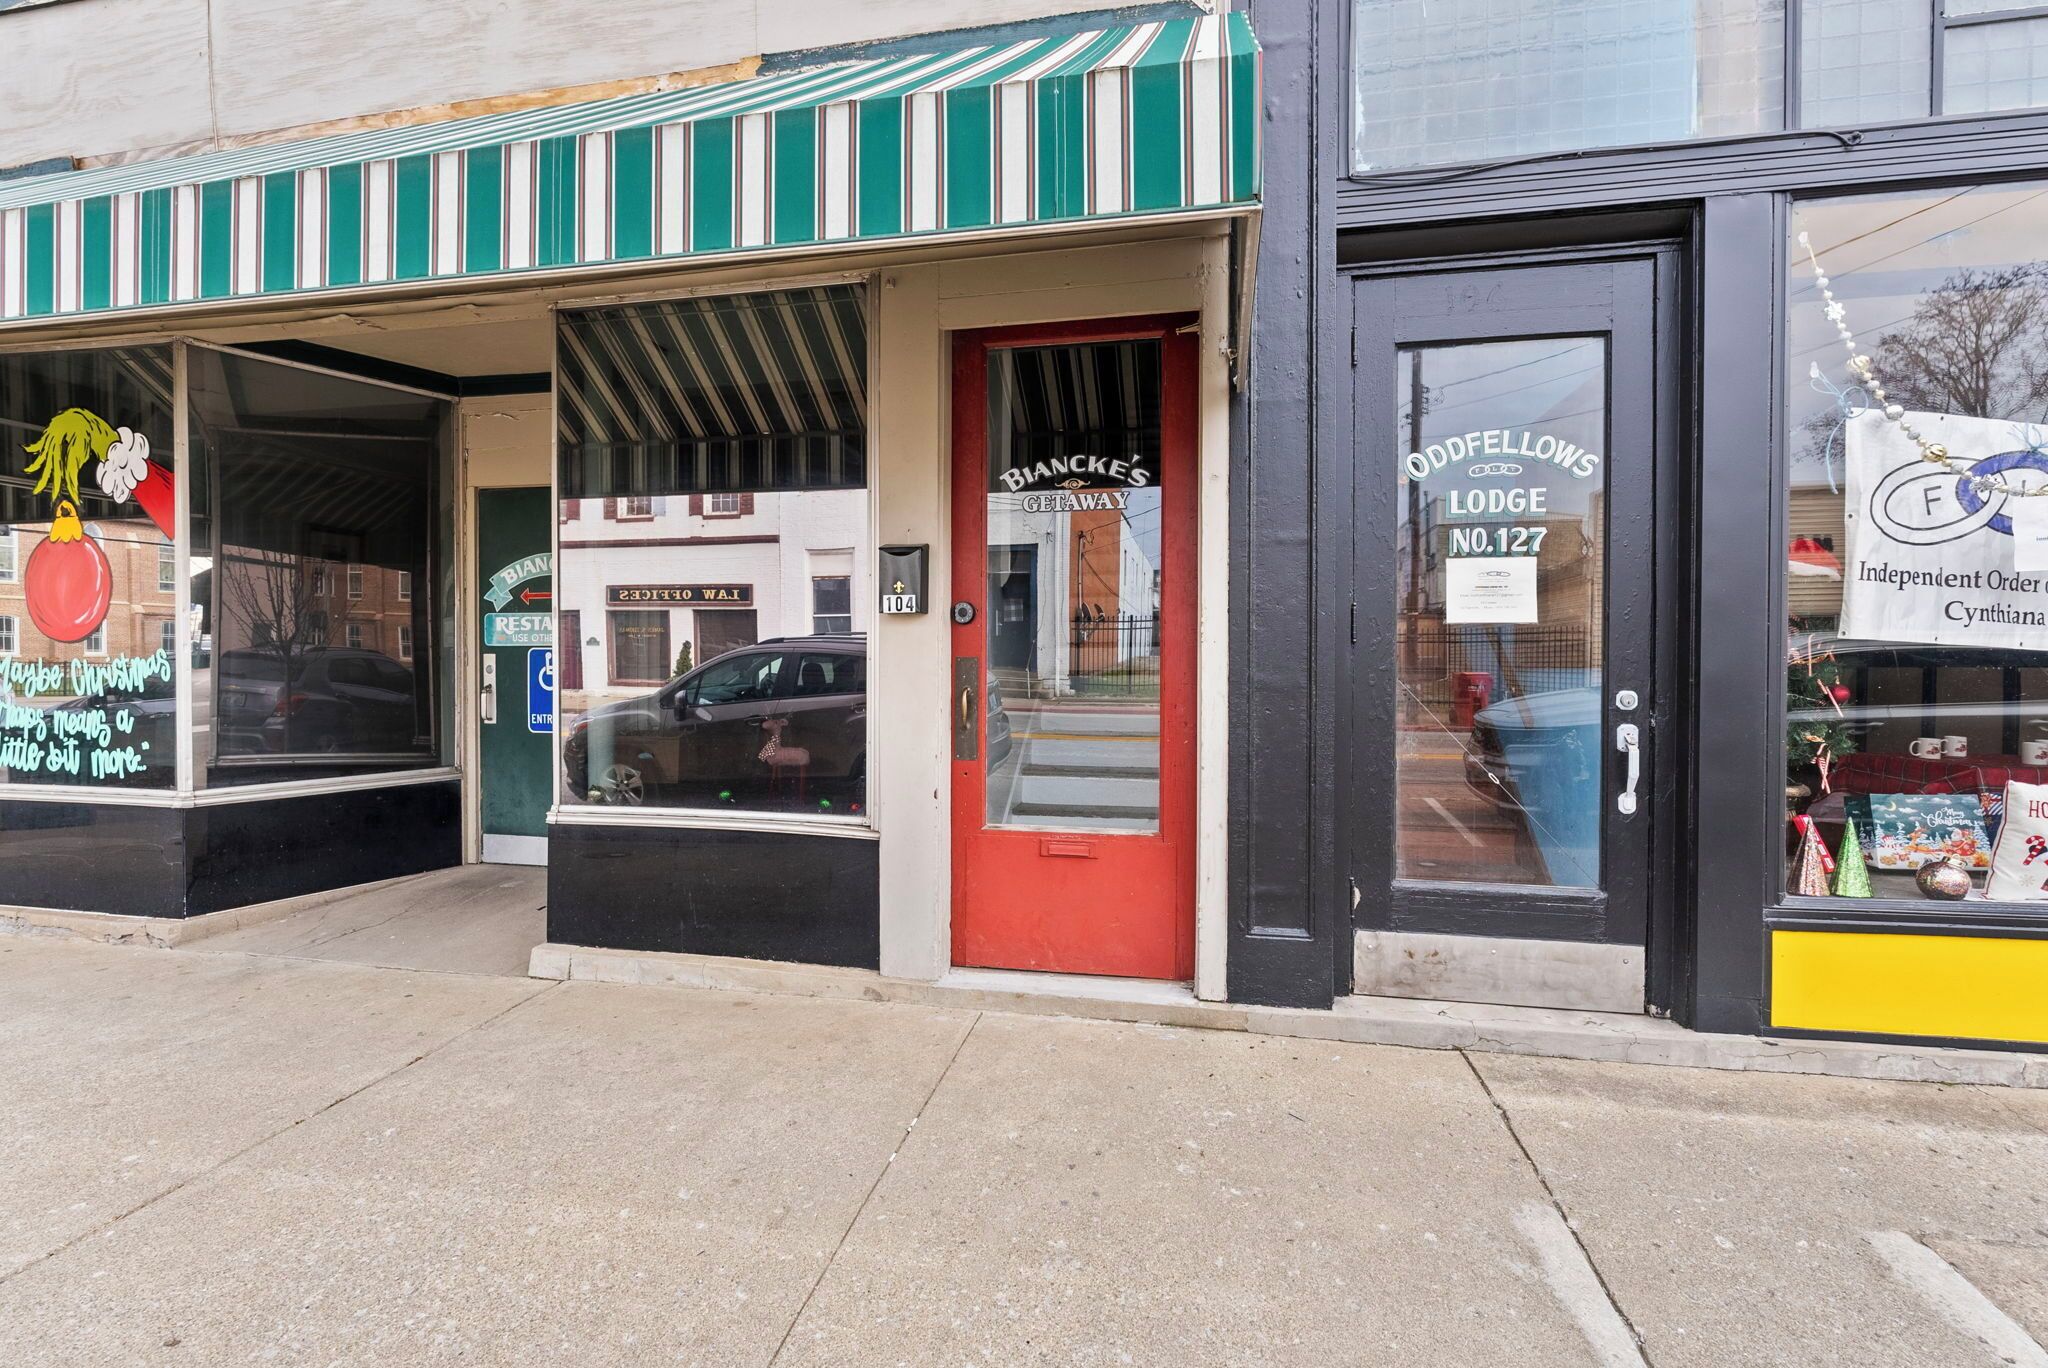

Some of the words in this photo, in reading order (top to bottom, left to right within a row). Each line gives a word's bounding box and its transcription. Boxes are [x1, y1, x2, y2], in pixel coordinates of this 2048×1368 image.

[1405, 430, 1600, 480] ODDFELLOWS
[1022, 491, 1130, 513] GETAWAY
[1448, 487, 1547, 516] LODGE
[1923, 485, 1942, 516] F
[500, 556, 552, 585] BIAN
[1858, 560, 1982, 591] Independent
[1987, 569, 2040, 593] Order
[886, 596, 914, 612] 104
[1944, 600, 2046, 628] Cynthiana
[495, 616, 552, 635] RESTA
[512, 633, 528, 642] USE
[71, 648, 171, 697] Christmas
[54, 709, 111, 747] means
[116, 708, 134, 734] a
[531, 713, 553, 724] ENTR
[46, 737, 80, 775] bit
